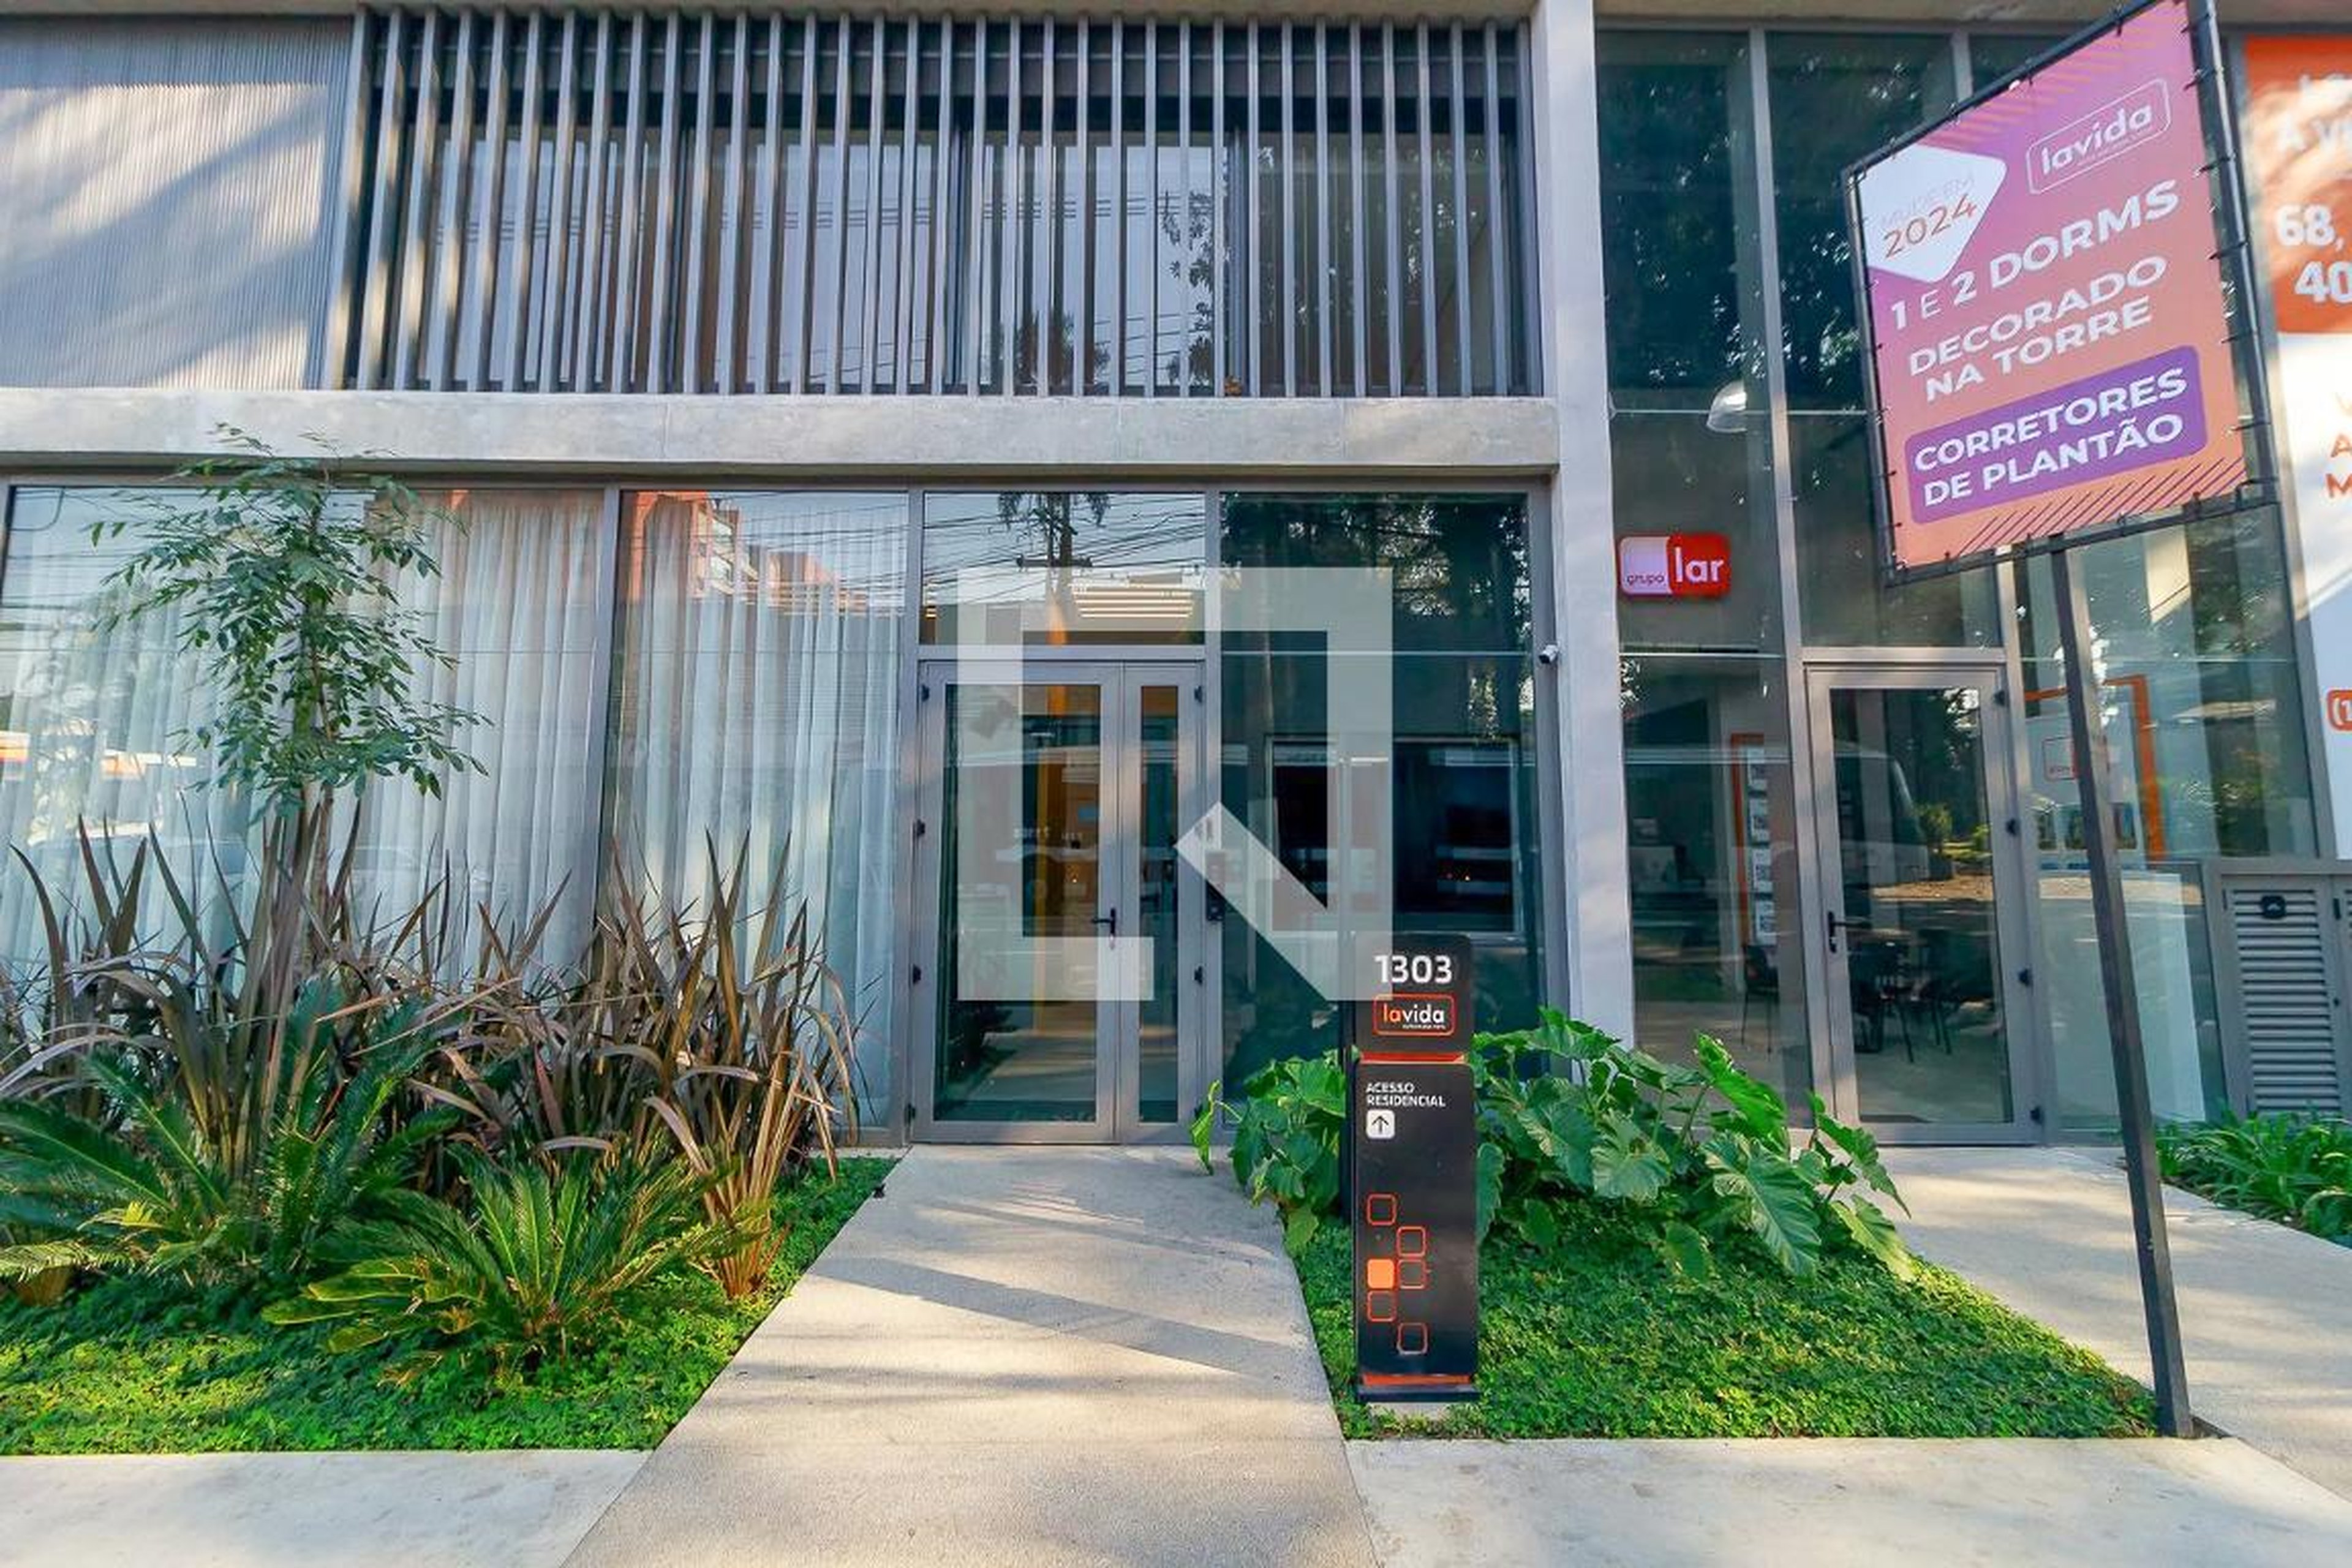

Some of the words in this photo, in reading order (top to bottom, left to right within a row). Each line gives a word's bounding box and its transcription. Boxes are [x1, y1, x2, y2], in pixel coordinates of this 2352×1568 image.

[2041, 105, 2152, 175] lavida
[1883, 193, 1977, 258] 2024
[1891, 300, 1907, 330] 1
[1921, 289, 1942, 320] E
[1951, 270, 1977, 305] 2
[1990, 179, 2179, 288] DORMS
[1909, 255, 2168, 376] DECORADO
[1926, 363, 1985, 402] NA
[1992, 295, 2153, 374] TORRE
[1915, 368, 2188, 471] CORRETORES
[1924, 472, 1972, 507] DE
[1983, 413, 2184, 491] PLANTÃO
[1627, 573, 1665, 586] grupo
[1675, 547, 1724, 582] lar
[1374, 954, 1452, 983] 1303
[1384, 1003, 1445, 1023] lavida
[1366, 1081, 1415, 1093] ACESSO
[1366, 1095, 1446, 1107] RESIDENCIAL
